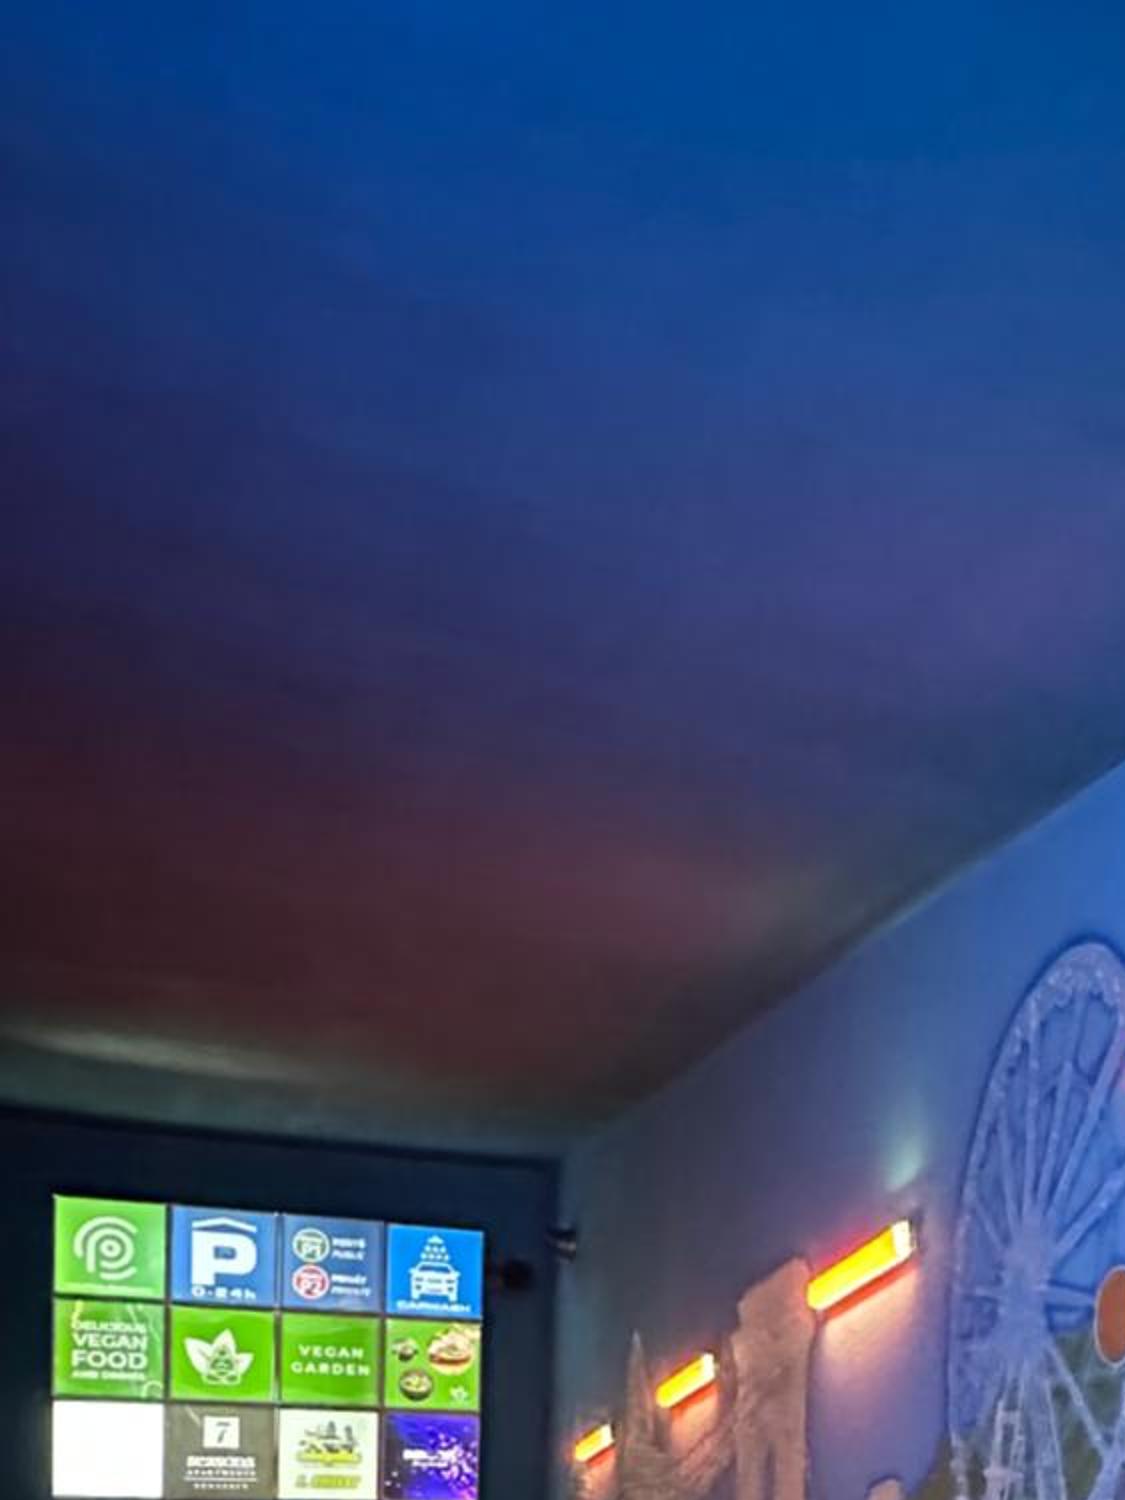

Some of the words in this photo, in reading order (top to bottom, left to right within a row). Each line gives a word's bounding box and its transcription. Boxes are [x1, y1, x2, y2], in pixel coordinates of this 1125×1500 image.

[72, 1332, 148, 1350] VEGAN
[71, 1350, 148, 1370] FOOD
[297, 1344, 365, 1359] VEGAN
[290, 1361, 371, 1377] GARDEN
[216, 1421, 231, 1443] 7
